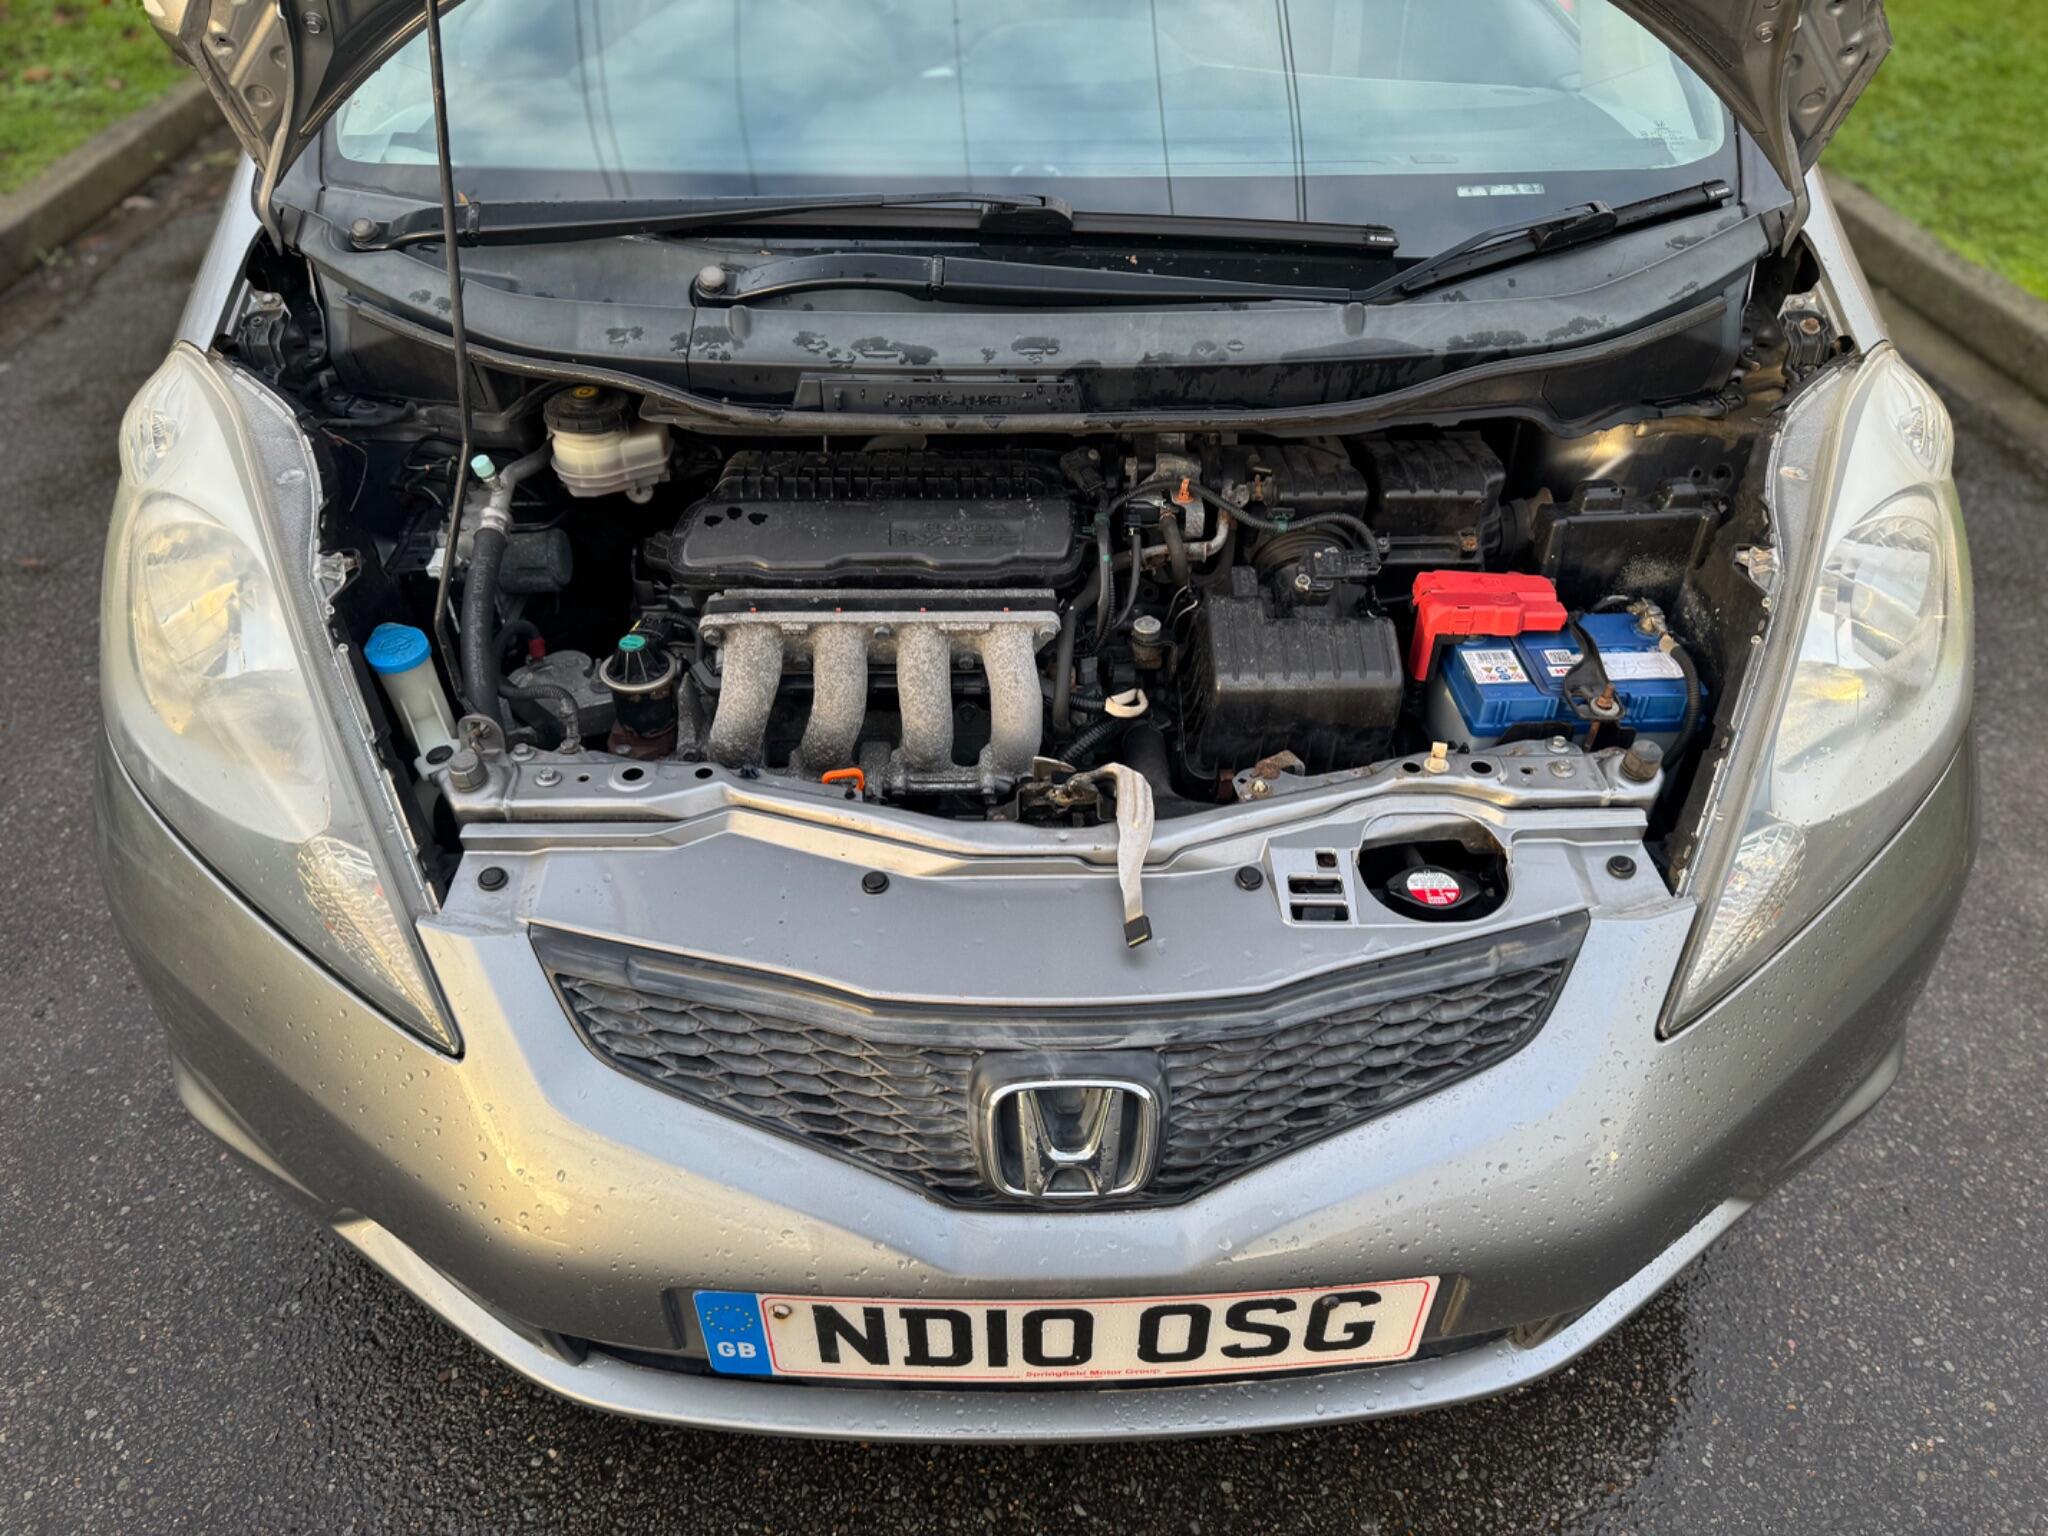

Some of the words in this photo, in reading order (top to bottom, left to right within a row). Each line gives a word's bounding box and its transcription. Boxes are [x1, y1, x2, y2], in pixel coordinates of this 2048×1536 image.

[812, 1304, 1094, 1368] ND10
[1137, 1290, 1382, 1364] OSG
[717, 1341, 757, 1359] GB
[1025, 1370, 1087, 1378] Springfield
[1124, 1368, 1161, 1376] Group
